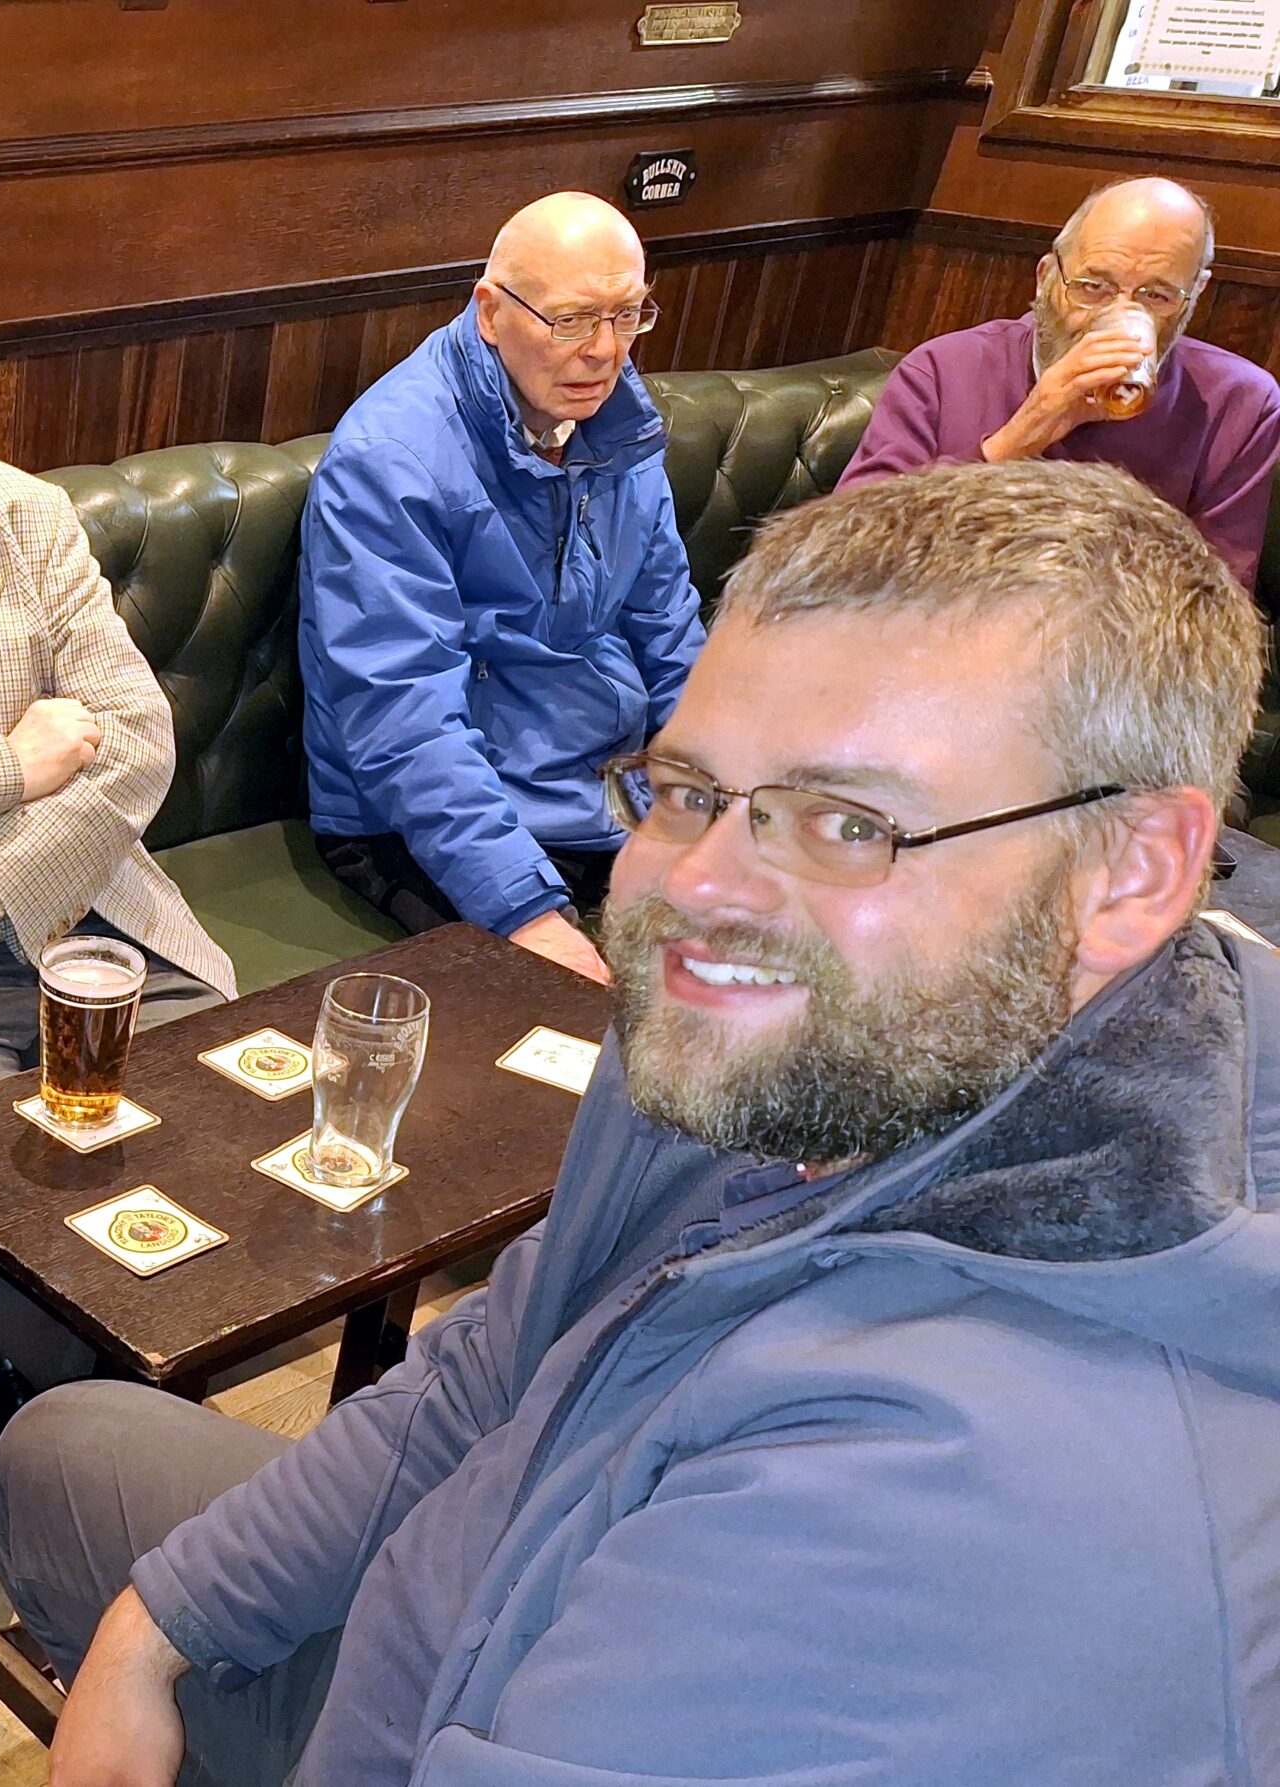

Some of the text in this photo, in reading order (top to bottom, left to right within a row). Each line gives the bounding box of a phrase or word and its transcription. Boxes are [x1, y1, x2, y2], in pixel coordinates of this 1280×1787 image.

[642, 158, 687, 186] BULLSHIT
[641, 182, 681, 201] CORNER
[133, 1213, 178, 1225] TAYLOR'S
[140, 1228, 180, 1249] LANDLORD
